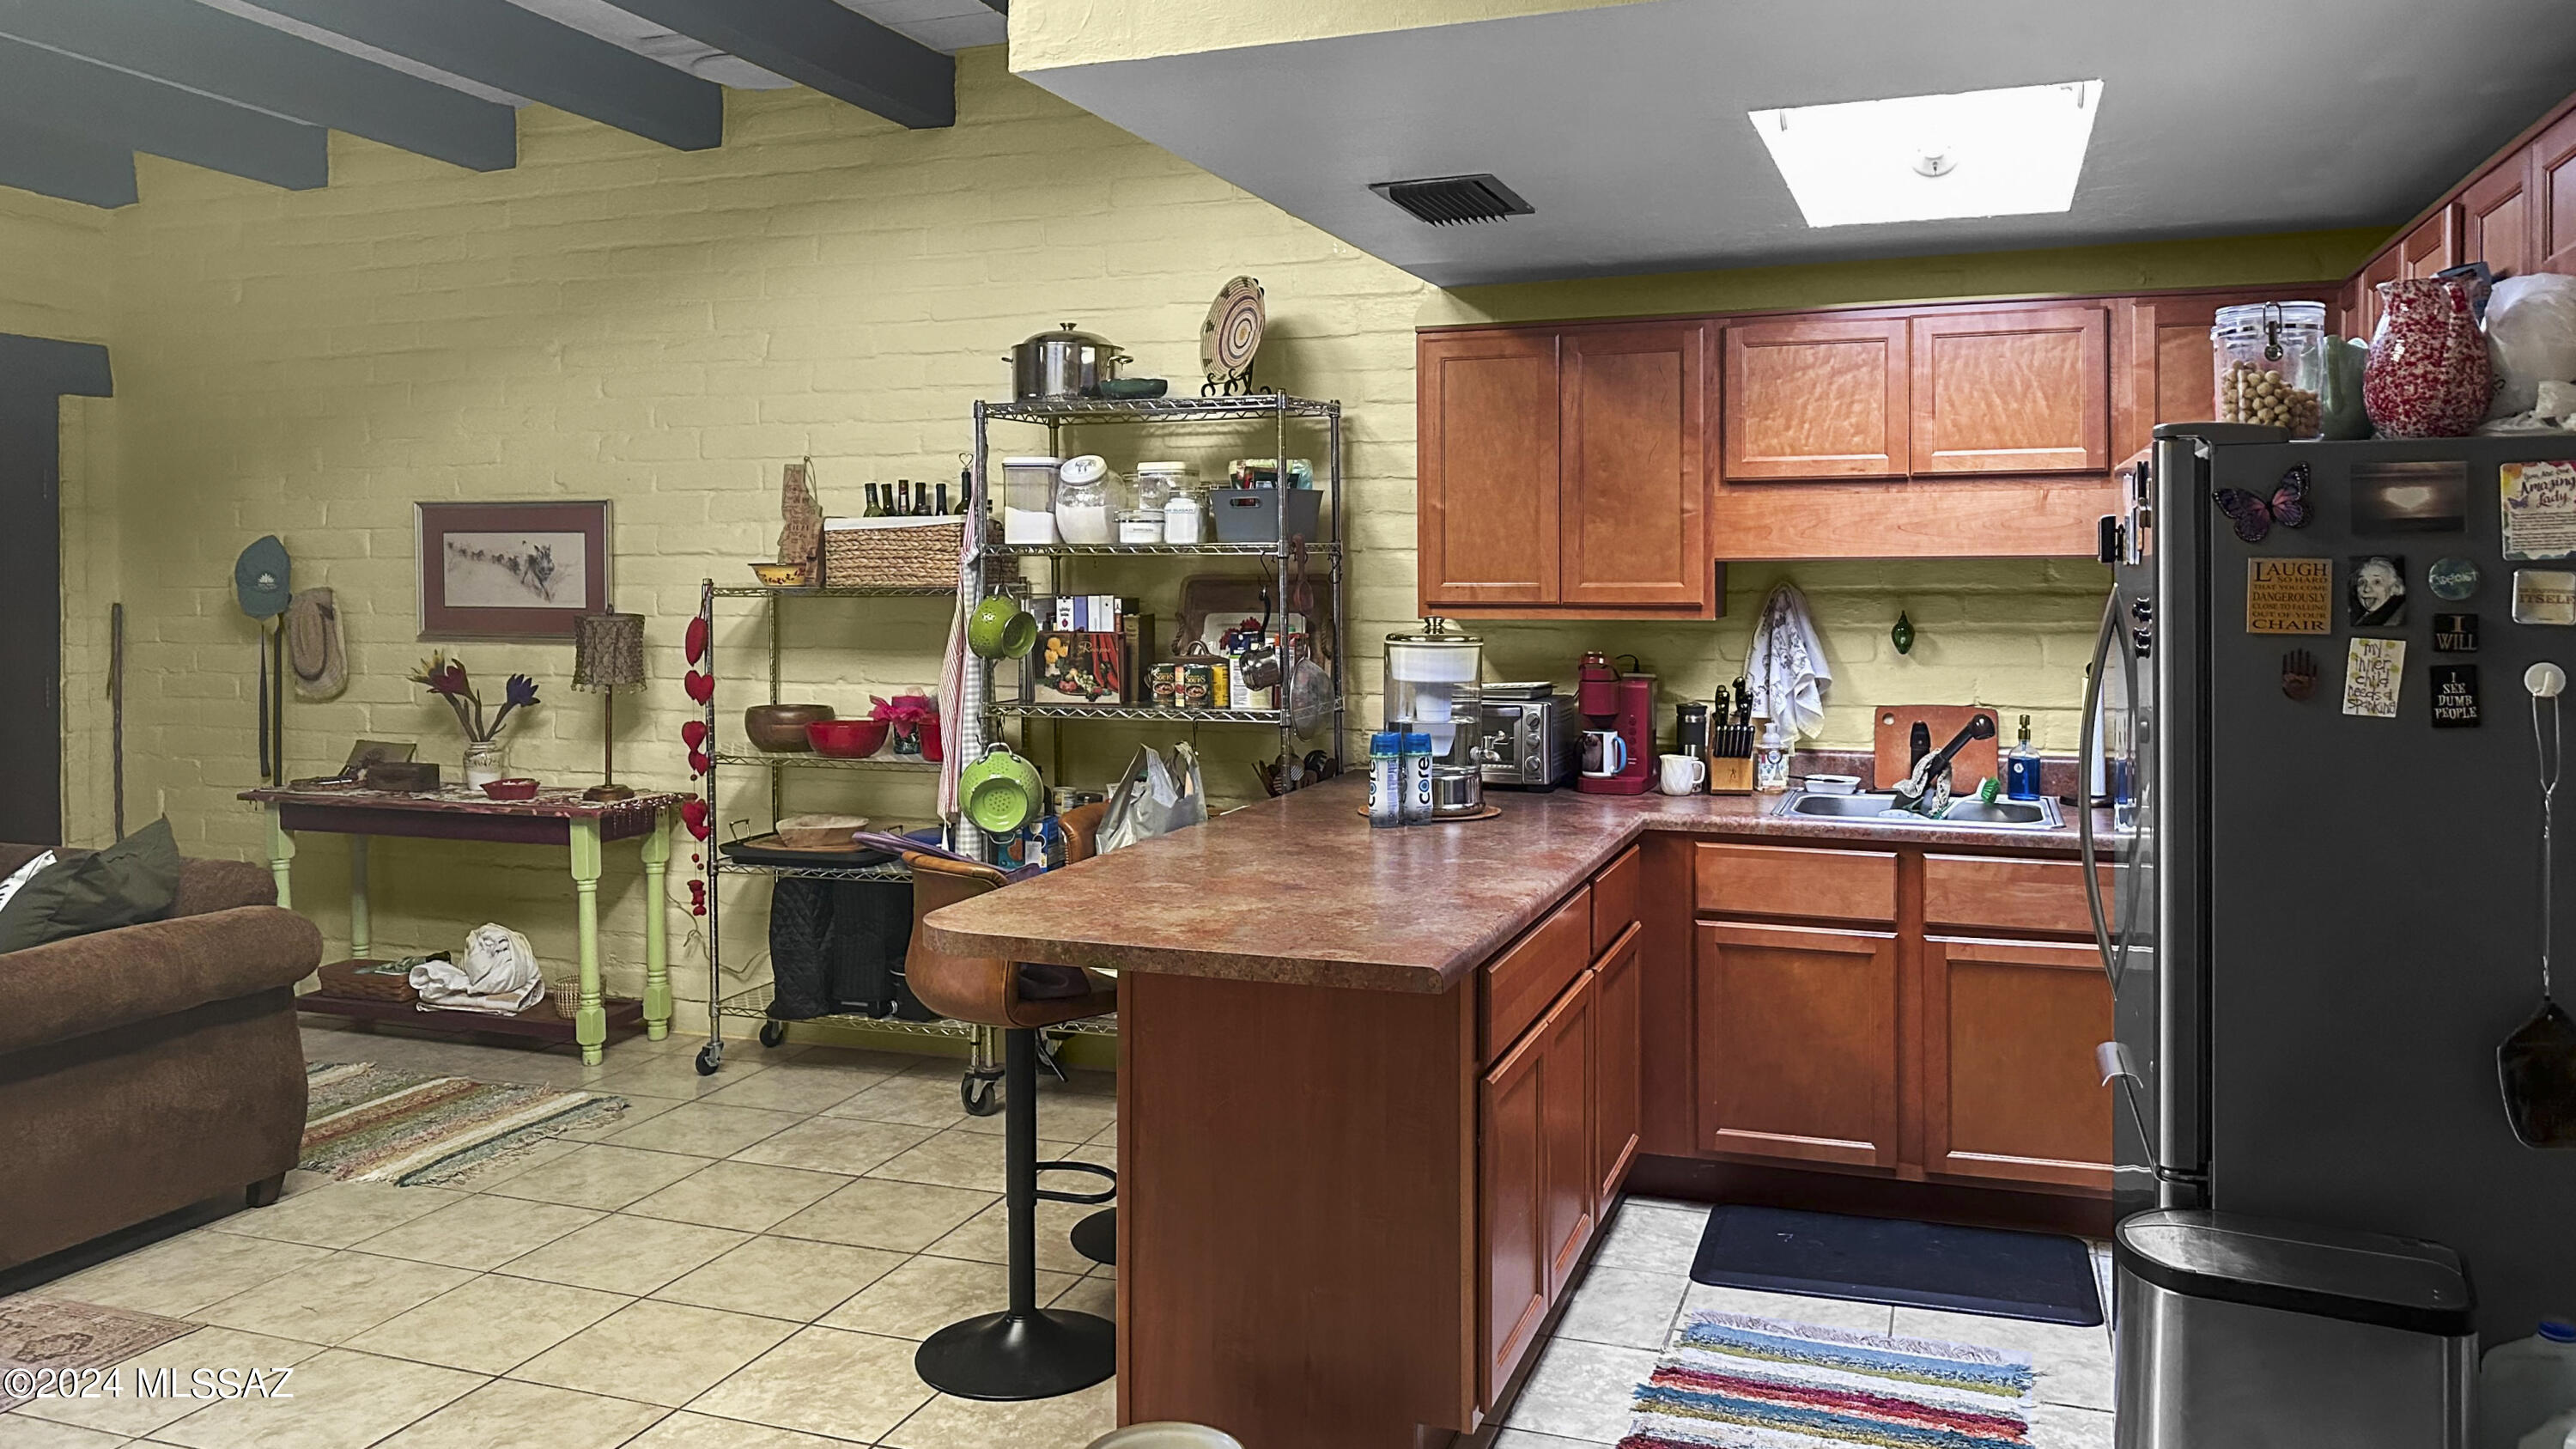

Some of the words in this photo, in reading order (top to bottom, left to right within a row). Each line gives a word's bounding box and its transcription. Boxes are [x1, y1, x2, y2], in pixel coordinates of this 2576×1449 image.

[2520, 477, 2576, 496] Amazing
[2536, 490, 2568, 508] Lady
[2253, 562, 2327, 581] LAUGH
[2252, 591, 2327, 603] DANGEROUSLY
[2252, 618, 2325, 630] CHAIR
[2451, 615, 2466, 633] I
[2436, 633, 2477, 650] WILL
[2364, 642, 2383, 658] my
[2354, 654, 2391, 673] inner
[2354, 668, 2390, 688] child
[2451, 672, 2457, 683] I
[2348, 685, 2382, 701] needs
[2384, 689, 2393, 701] a
[2442, 683, 2466, 694] SEE
[2437, 695, 2474, 707] DUMB
[2433, 706, 2477, 720] PEOPLE
[1418, 756, 1431, 805] core
